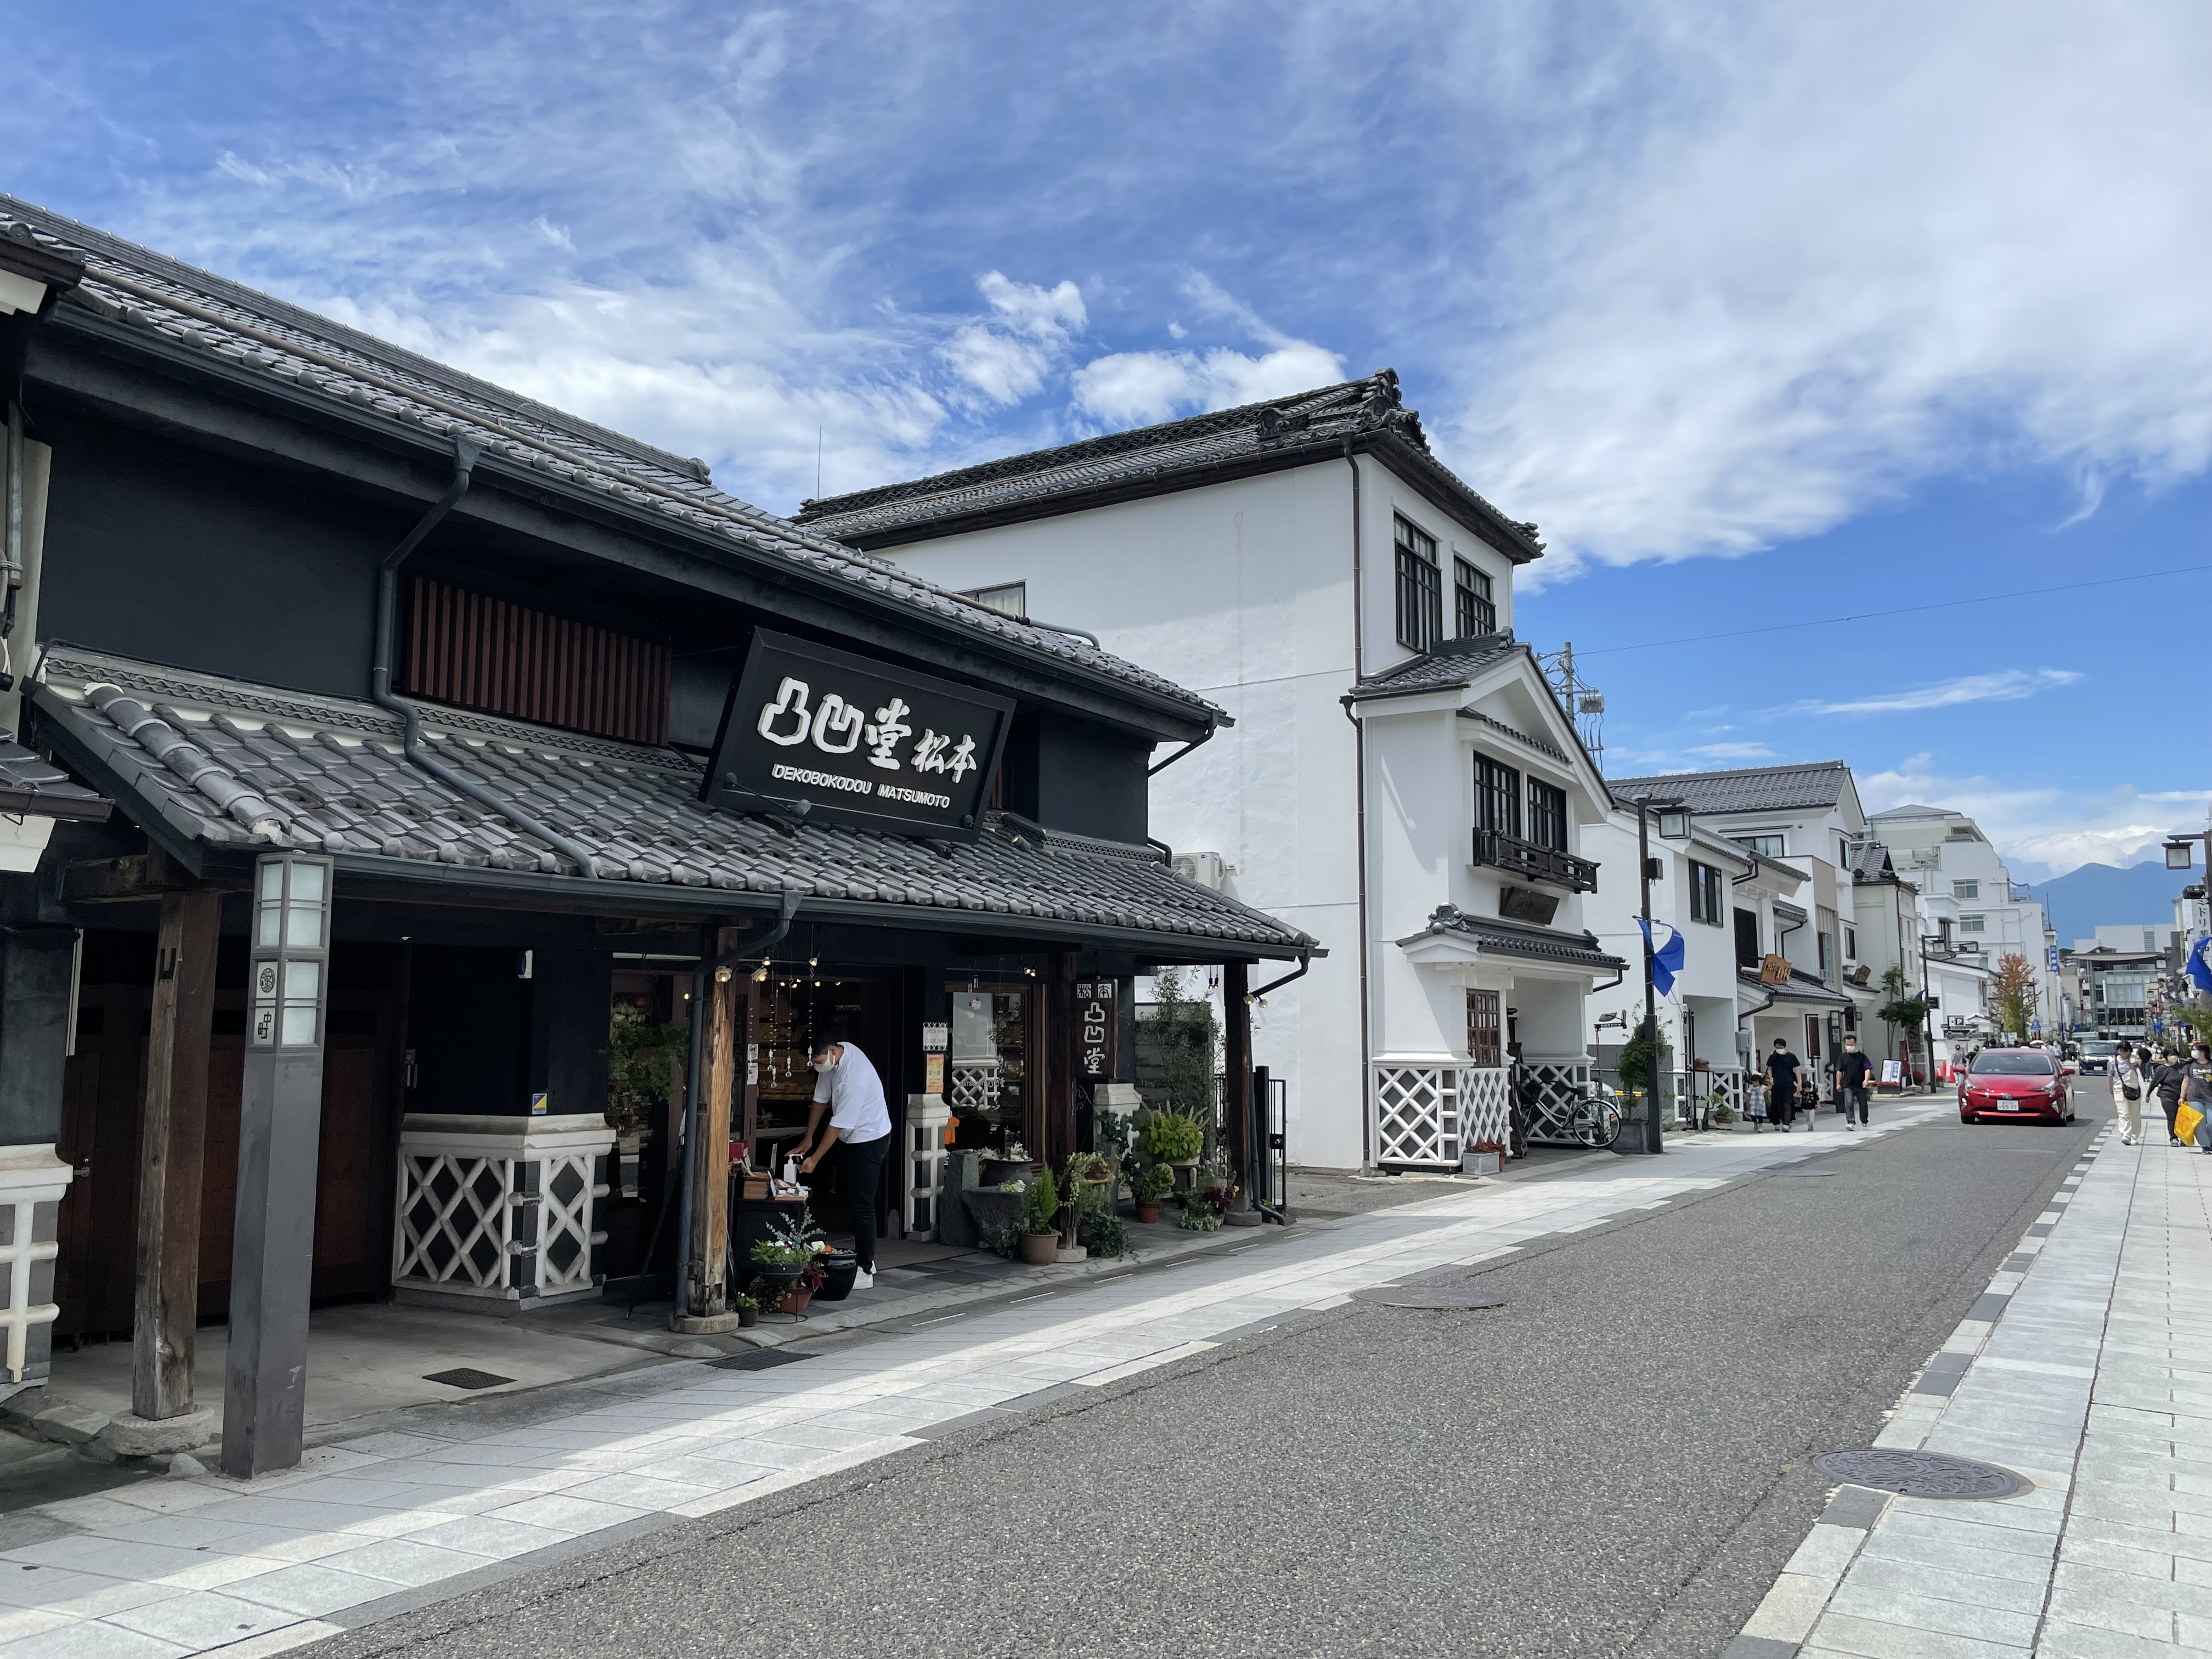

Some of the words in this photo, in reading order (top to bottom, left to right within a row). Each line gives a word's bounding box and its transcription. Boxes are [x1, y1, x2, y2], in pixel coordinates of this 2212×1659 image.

[771, 764, 872, 794] DEKOBOKODOU
[877, 783, 950, 809] MATSUMOTO
[1084, 1002, 1105, 1074] 凸凹堂
